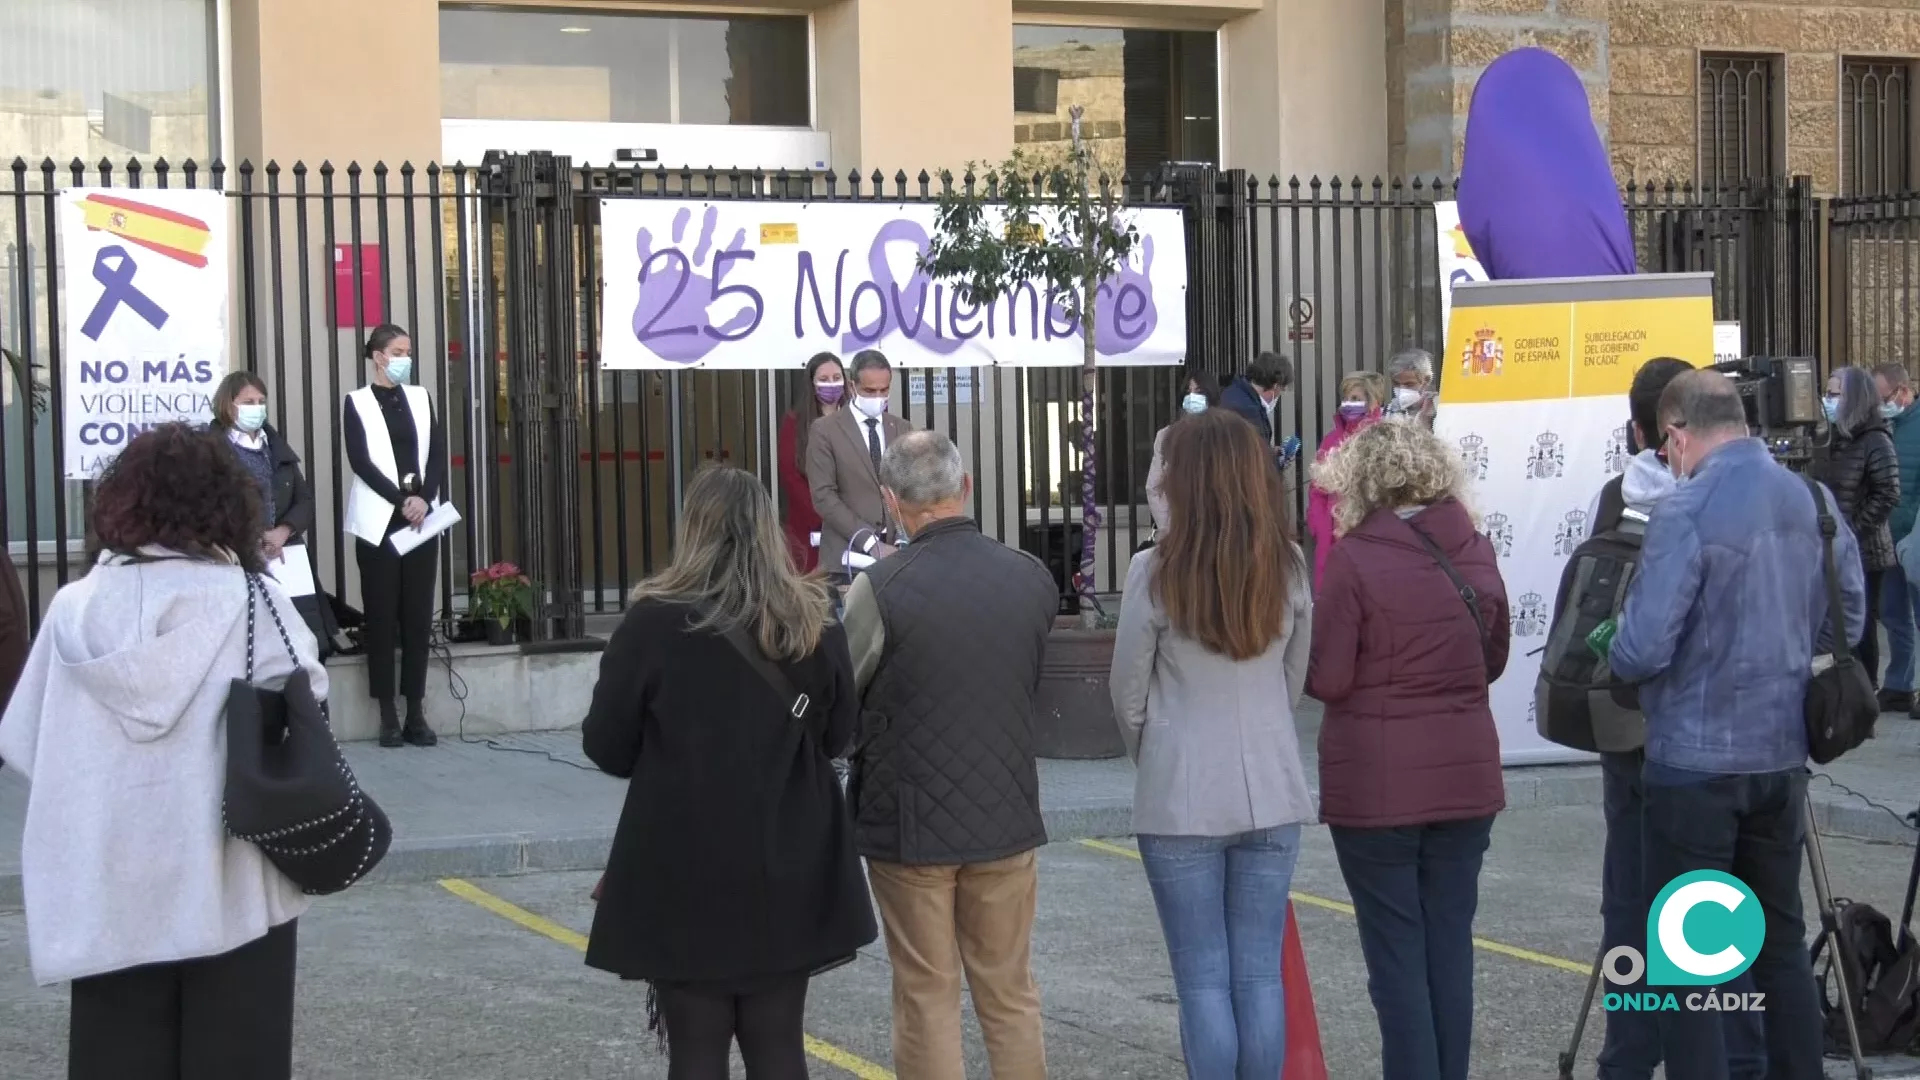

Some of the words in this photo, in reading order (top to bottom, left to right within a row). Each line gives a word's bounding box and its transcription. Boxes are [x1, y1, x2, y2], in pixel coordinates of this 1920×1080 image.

[637, 247, 764, 341] 25
[1514, 337, 1559, 350] GOBIERNO
[1584, 330, 1647, 343] SUBDELEGACIÓN
[1584, 344, 1599, 354] DEL
[1600, 342, 1639, 354] GOBIERNO
[1514, 352, 1526, 363] DE
[1527, 348, 1560, 362] ESPAÑA
[1584, 356, 1595, 366] EN
[1596, 353, 1619, 366] CÁDIZ
[80, 361, 129, 384] NO
[142, 353, 213, 384] MÁS
[80, 393, 213, 414] VIOLENCIA
